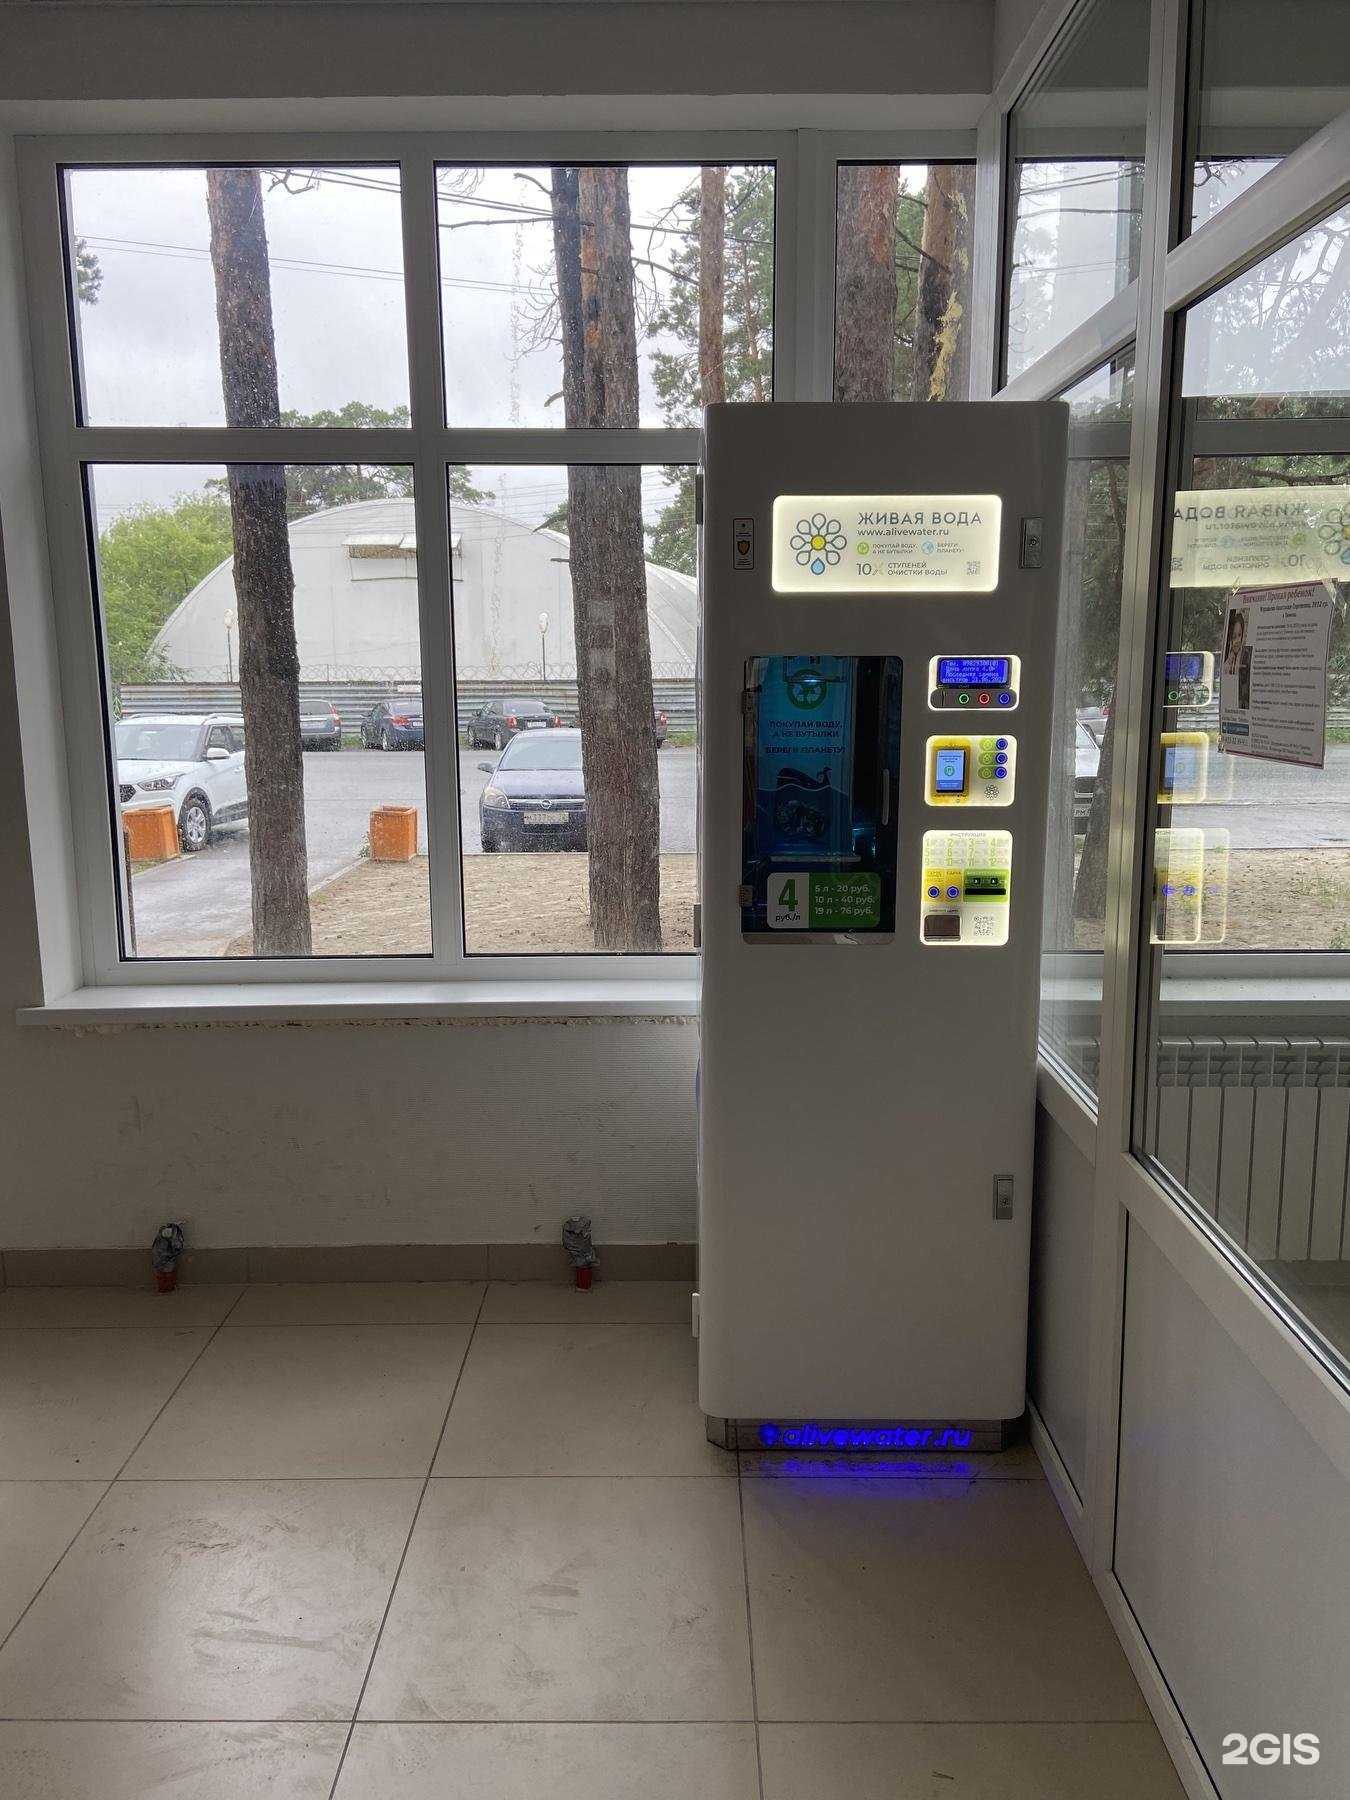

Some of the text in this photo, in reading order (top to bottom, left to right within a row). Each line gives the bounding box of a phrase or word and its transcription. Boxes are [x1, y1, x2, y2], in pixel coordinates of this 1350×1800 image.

[857, 511, 982, 526] ЖИВАЯ ВОДА
[857, 527, 949, 537] www.alivewater.ru
[887, 560, 927, 568] СТУПЕНЕЙ
[769, 719, 814, 728] ПОКУПАЙ
[850, 884, 871, 894] руб.
[778, 878, 799, 912] 4
[856, 896, 875, 905] руб.
[815, 907, 824, 915] 19
[840, 907, 852, 915] 76
[853, 907, 874, 916] руб.
[775, 912, 801, 922] руб./л
[783, 1423, 972, 1447] alivewater.ru
